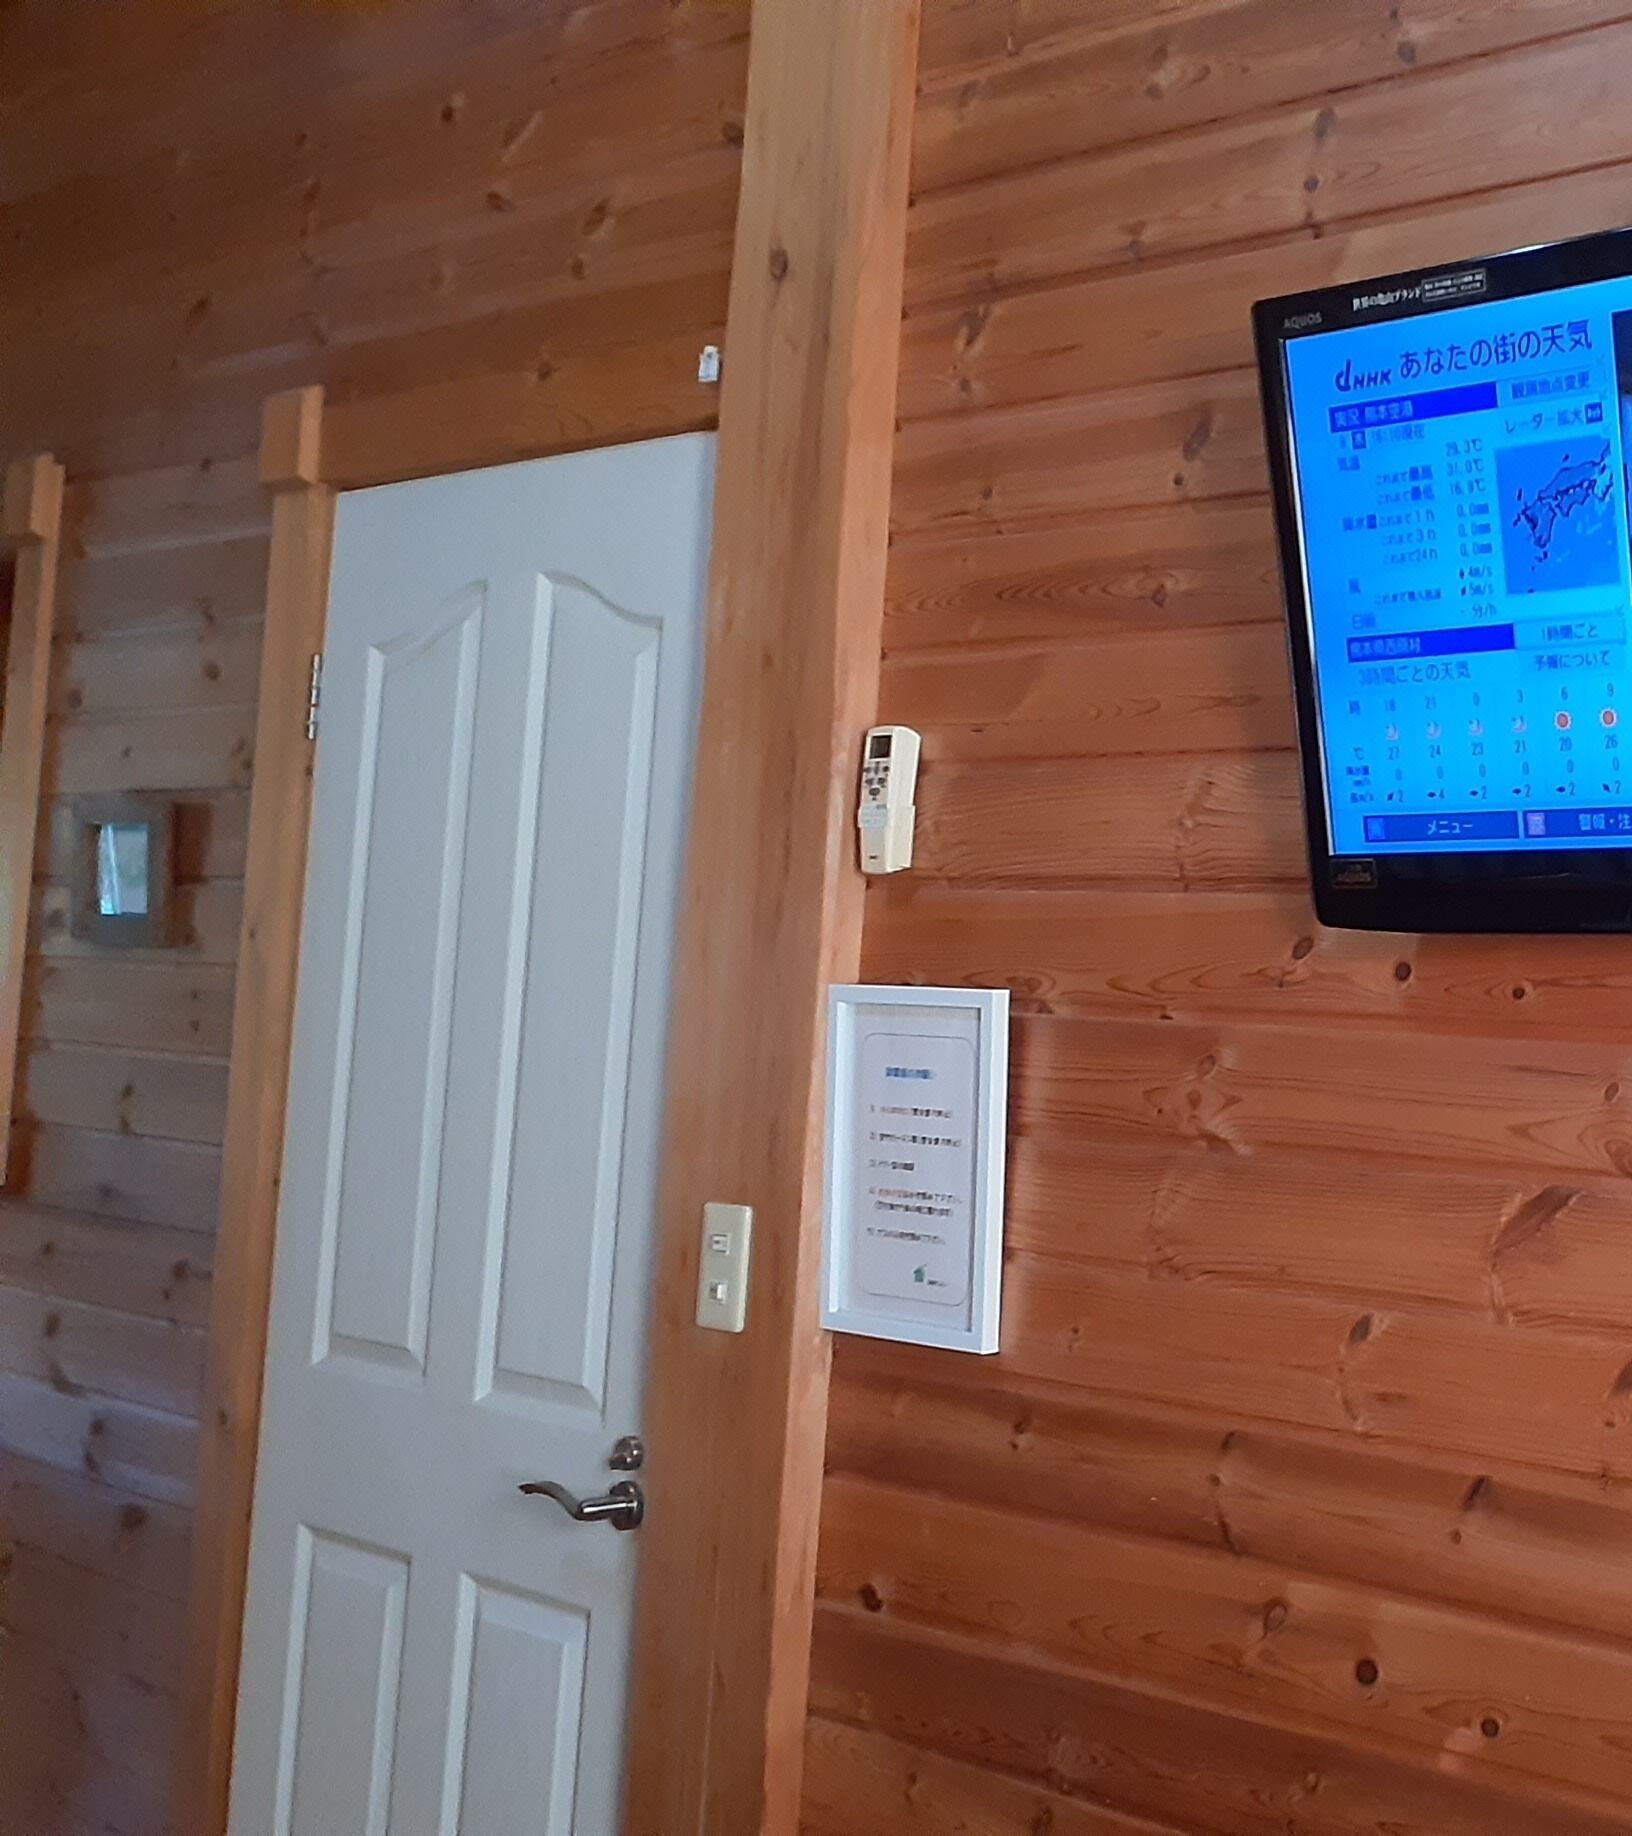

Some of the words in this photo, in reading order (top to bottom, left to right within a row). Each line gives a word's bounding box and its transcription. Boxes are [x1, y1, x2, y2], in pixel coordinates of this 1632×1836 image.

[1283, 311, 1322, 329] AQUOS
[1400, 319, 1593, 380] あなたの街の天気
[1427, 815, 1474, 836] メニュー
